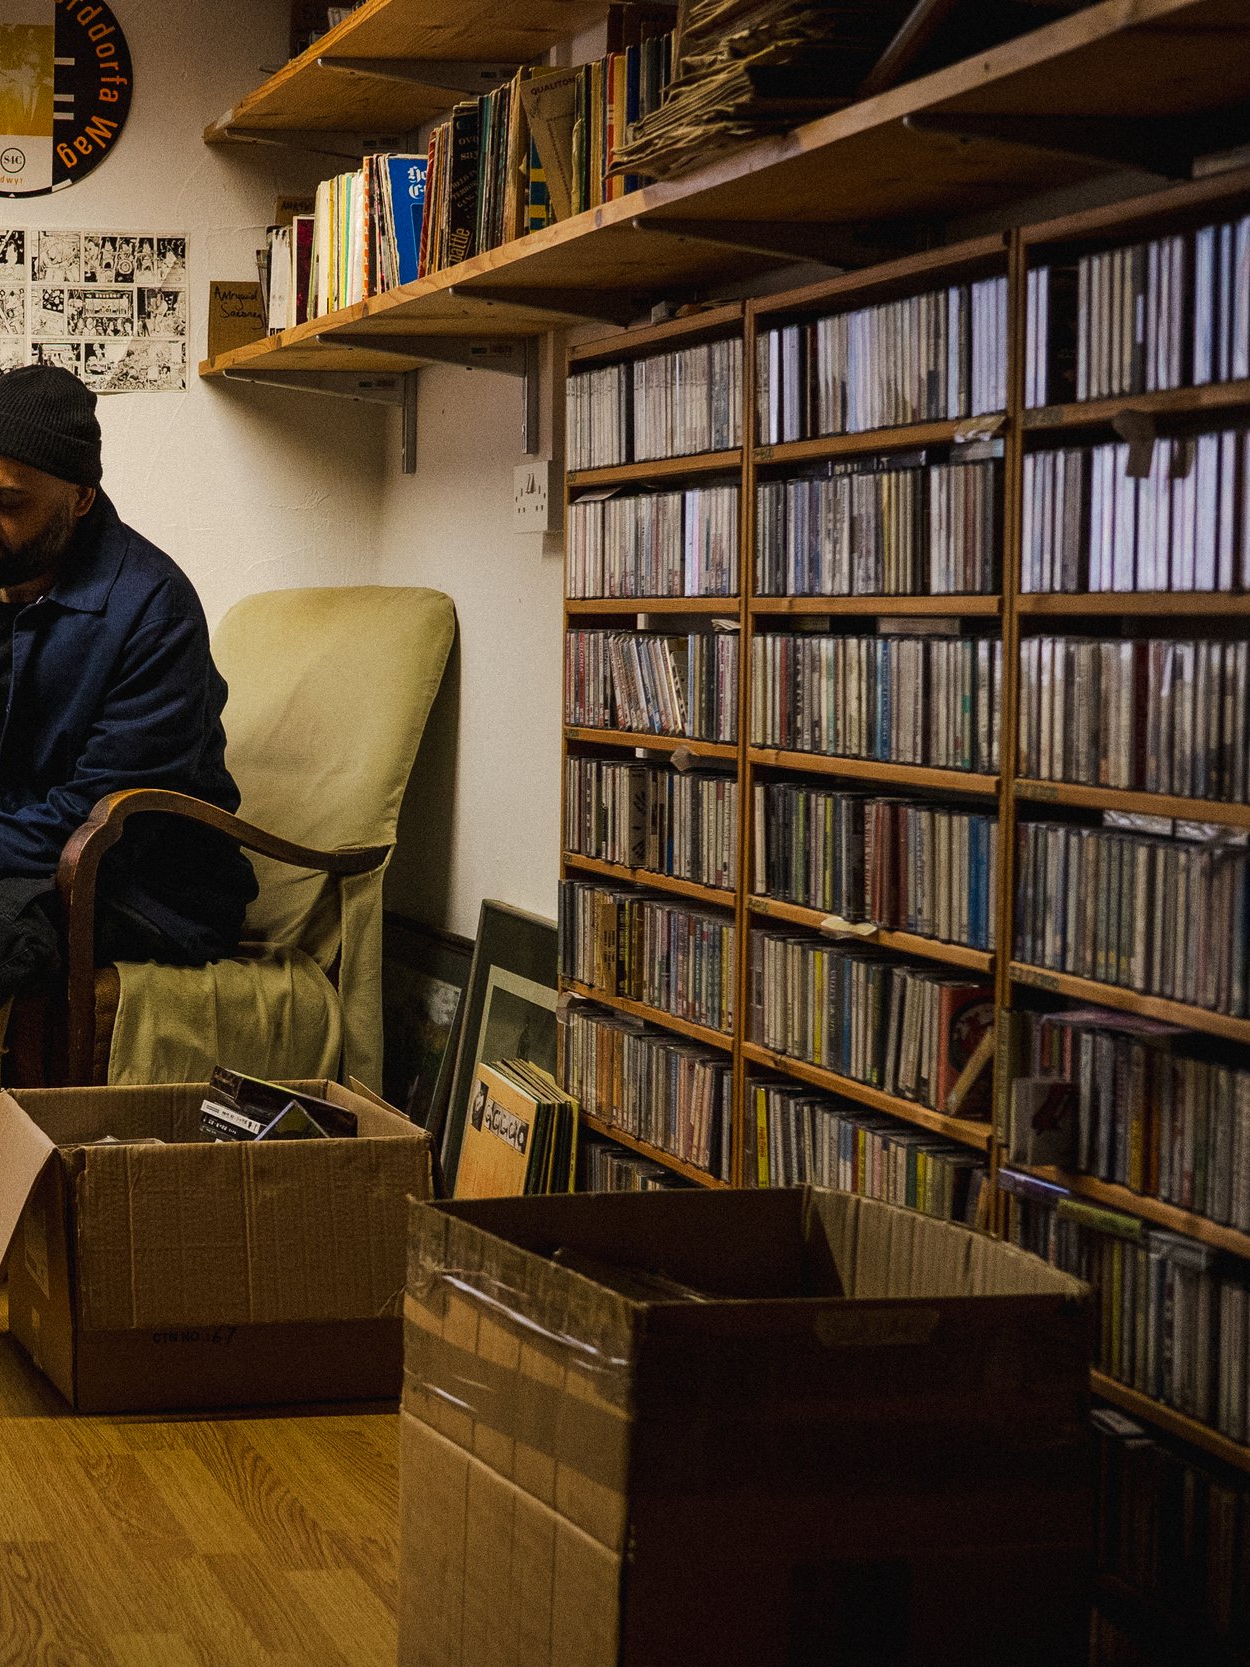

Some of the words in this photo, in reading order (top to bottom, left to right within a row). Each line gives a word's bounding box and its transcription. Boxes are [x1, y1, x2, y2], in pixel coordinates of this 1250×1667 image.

[56, 0, 128, 103] rddorfa
[530, 77, 576, 95] QUALITON
[56, 115, 119, 168] Wag
[3, 155, 23, 165] S4C
